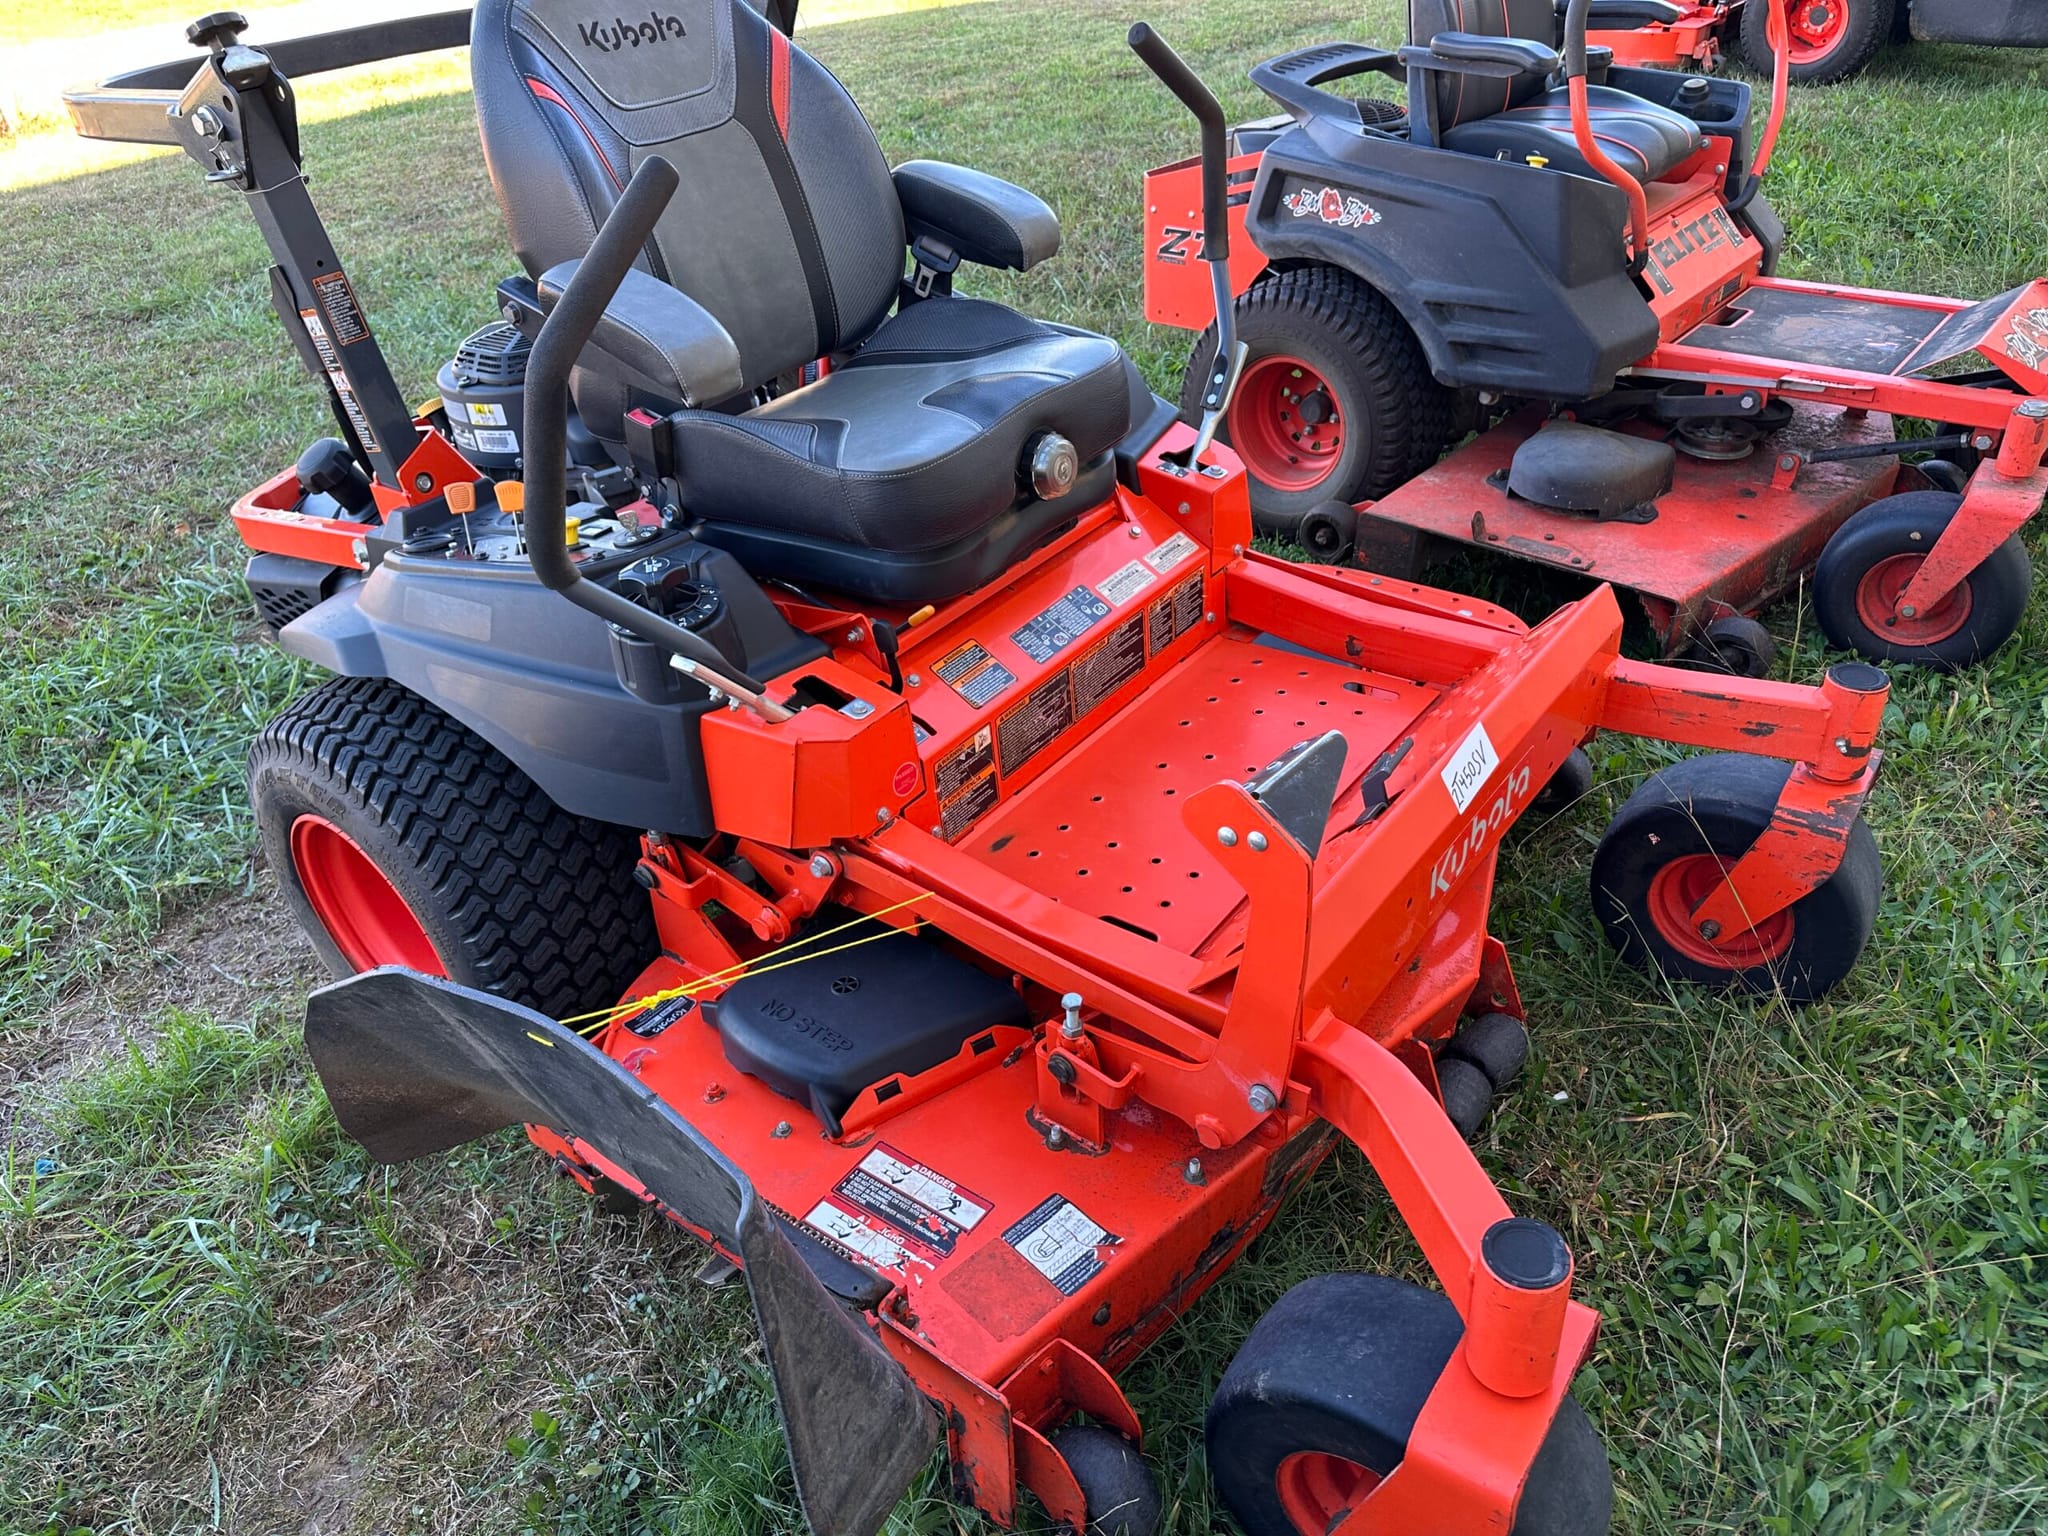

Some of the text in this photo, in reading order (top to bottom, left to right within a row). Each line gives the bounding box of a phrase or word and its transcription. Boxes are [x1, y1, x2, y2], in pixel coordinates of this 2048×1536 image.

[578, 11, 687, 52] Kubota
[1651, 213, 1721, 269] ELITE
[1430, 766, 1530, 899] Kubota
[761, 999, 854, 1053] NO STEP
[917, 1166, 957, 1190] DANGER
